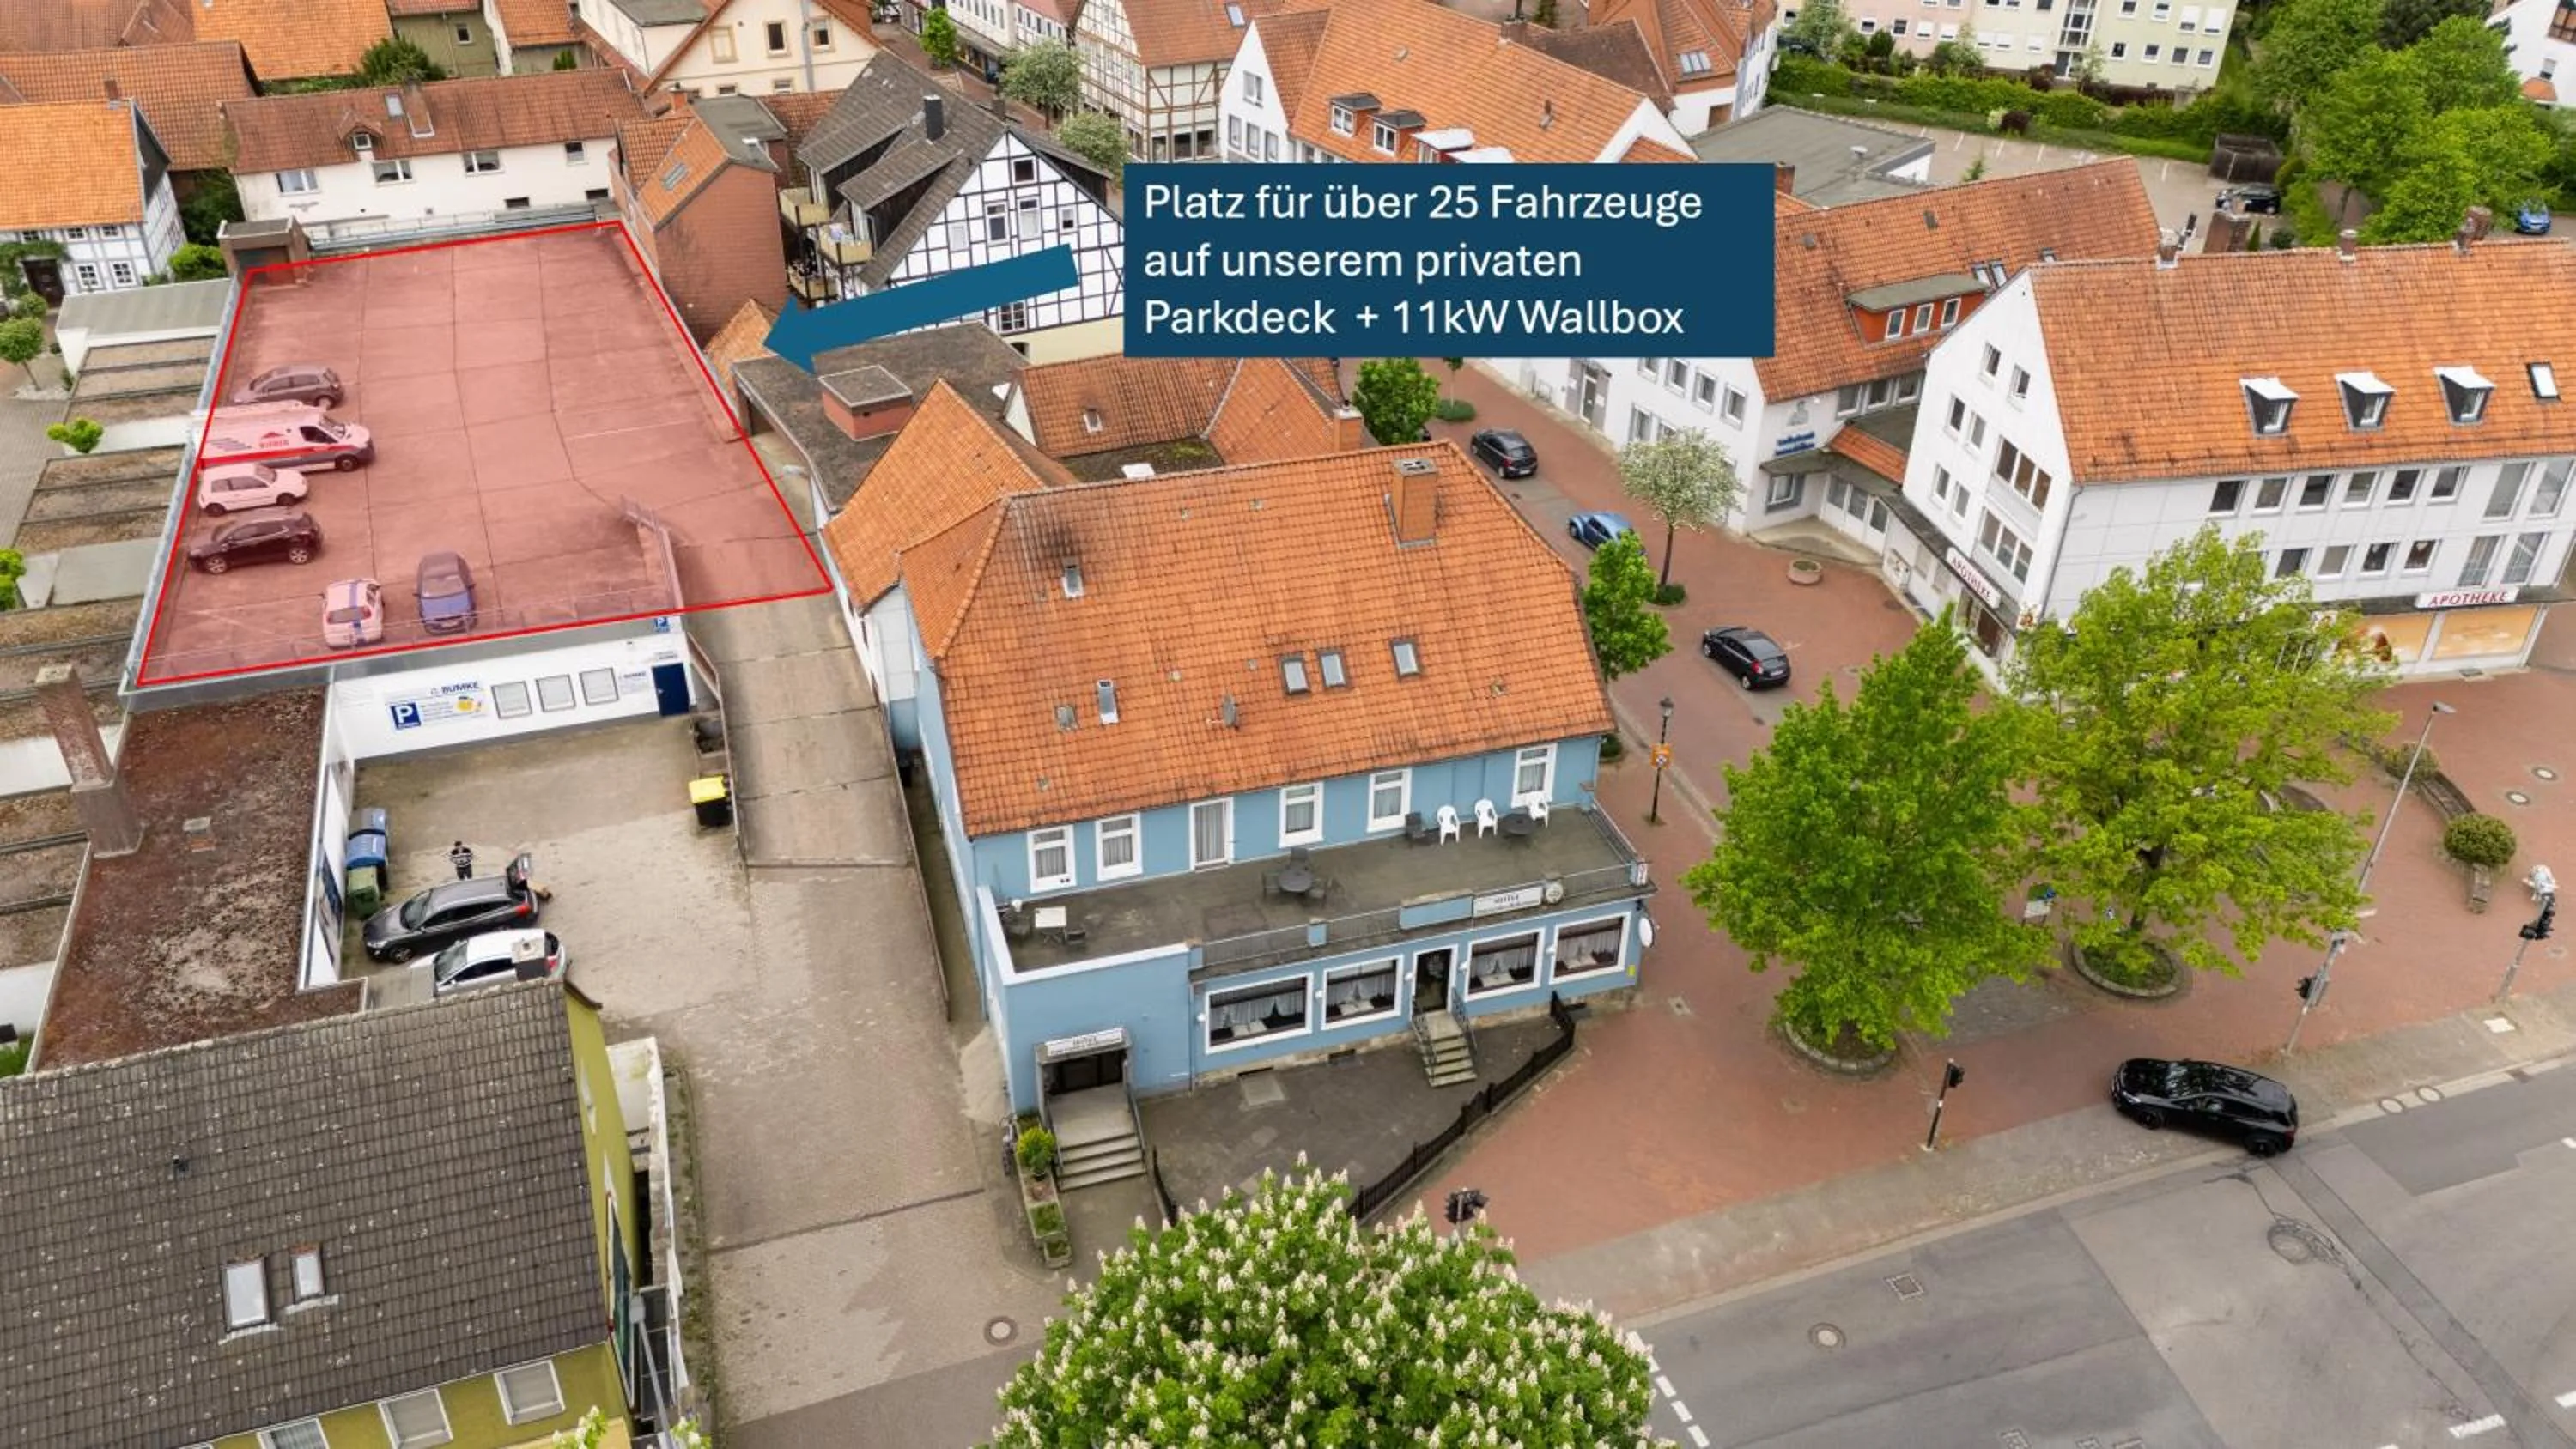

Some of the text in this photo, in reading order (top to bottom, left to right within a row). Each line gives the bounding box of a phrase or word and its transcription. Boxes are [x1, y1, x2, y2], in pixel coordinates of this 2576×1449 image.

[1950, 555, 1991, 599] APOTHEKE
[2427, 591, 2507, 608] APOTHEKE
[395, 705, 414, 724] P
